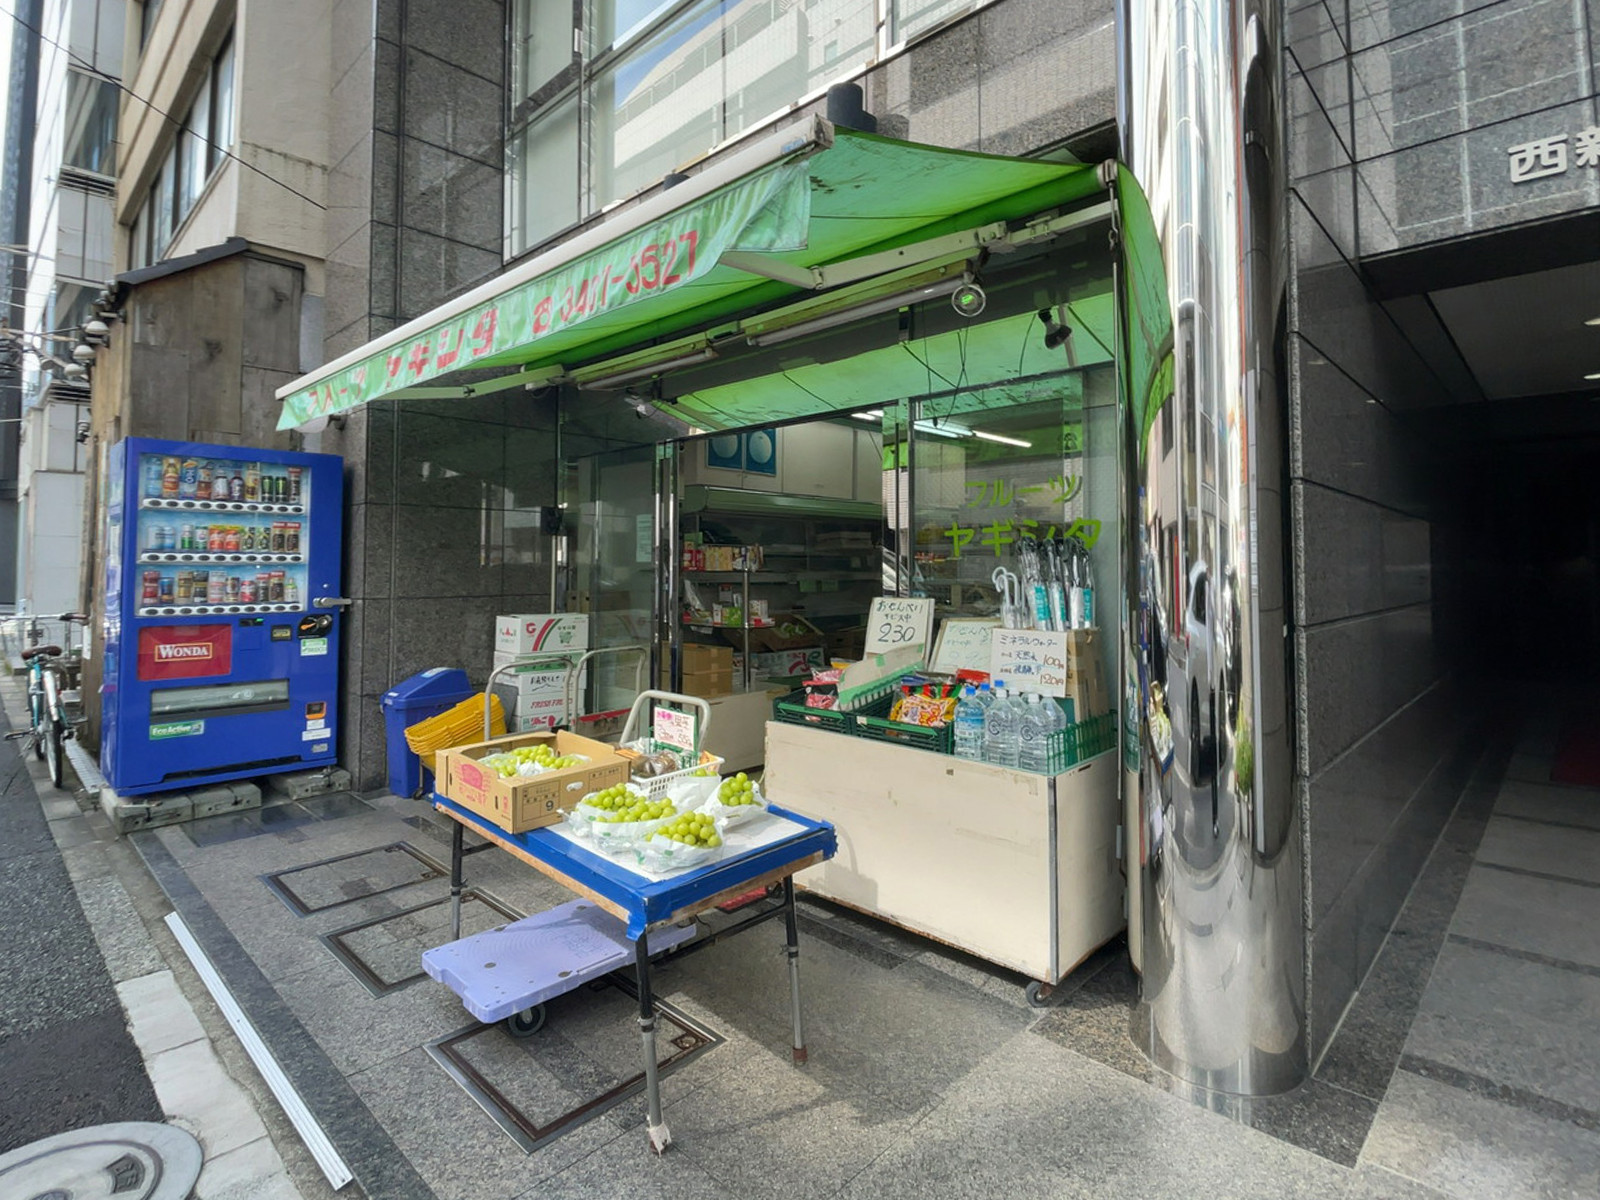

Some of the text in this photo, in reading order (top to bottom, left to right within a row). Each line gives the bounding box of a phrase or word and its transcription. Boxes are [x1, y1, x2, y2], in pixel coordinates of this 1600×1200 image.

[964, 474, 1077, 508] フルーツ
[944, 517, 1102, 558] ヤギシタ
[878, 622, 915, 643] 230
[159, 644, 209, 659] WONDA
